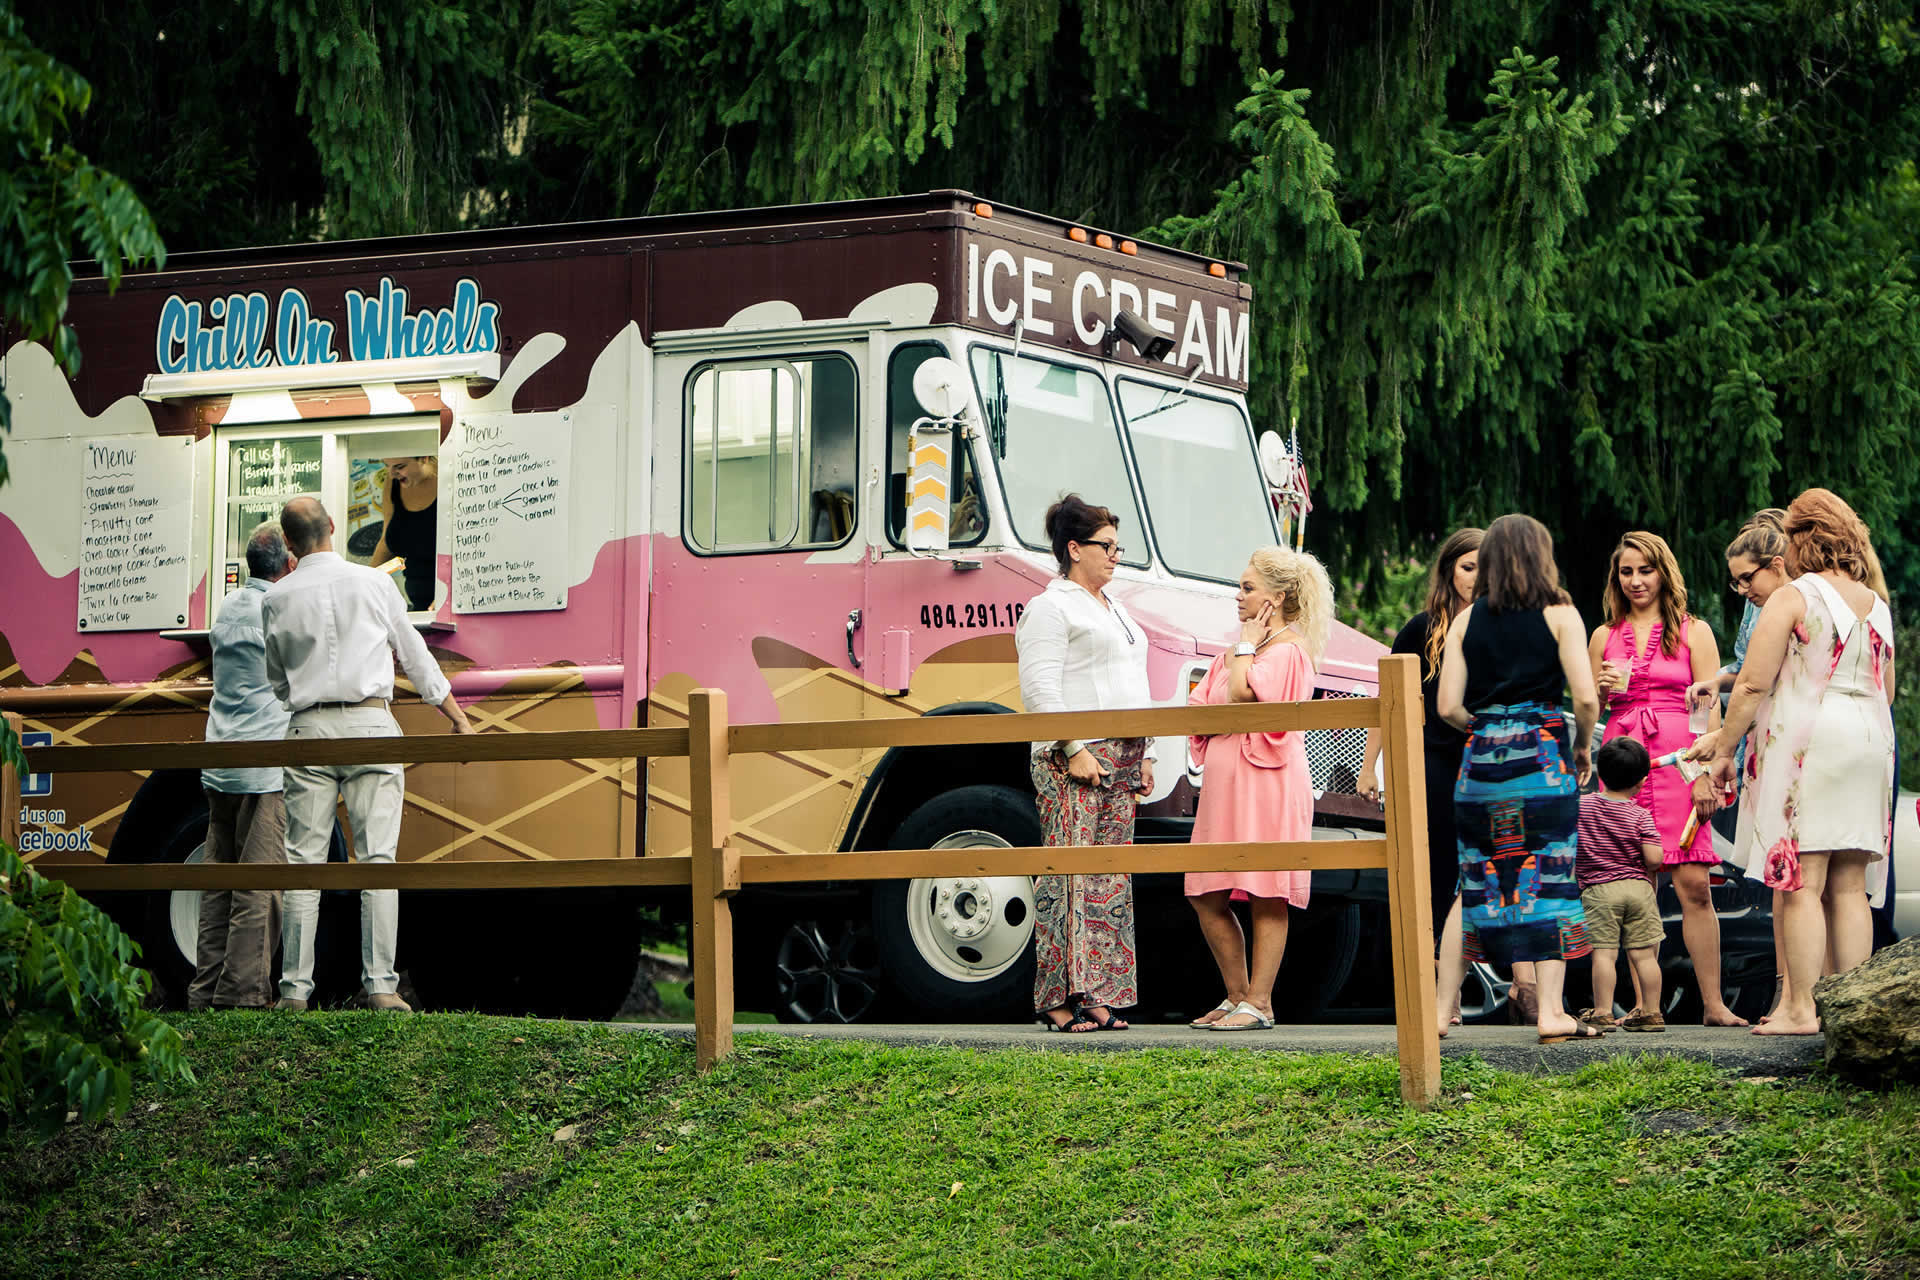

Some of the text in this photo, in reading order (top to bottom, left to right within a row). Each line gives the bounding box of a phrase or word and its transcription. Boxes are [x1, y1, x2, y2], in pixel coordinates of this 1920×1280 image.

[968, 243, 1249, 383] ICE CREAM
[156, 277, 500, 373] Chill On Wheels
[235, 446, 256, 464] Call
[258, 448, 271, 460] us
[492, 452, 530, 465] Sandwich
[289, 460, 321, 476] parties
[456, 502, 486, 517] Sundae
[457, 567, 474, 581] Jolly
[459, 583, 476, 595] Jolly
[84, 596, 105, 610] Twix
[920, 603, 1024, 628] 484.291.16
[30, 809, 46, 824] us
[48, 809, 66, 824] on
[19, 825, 93, 851] cebook
